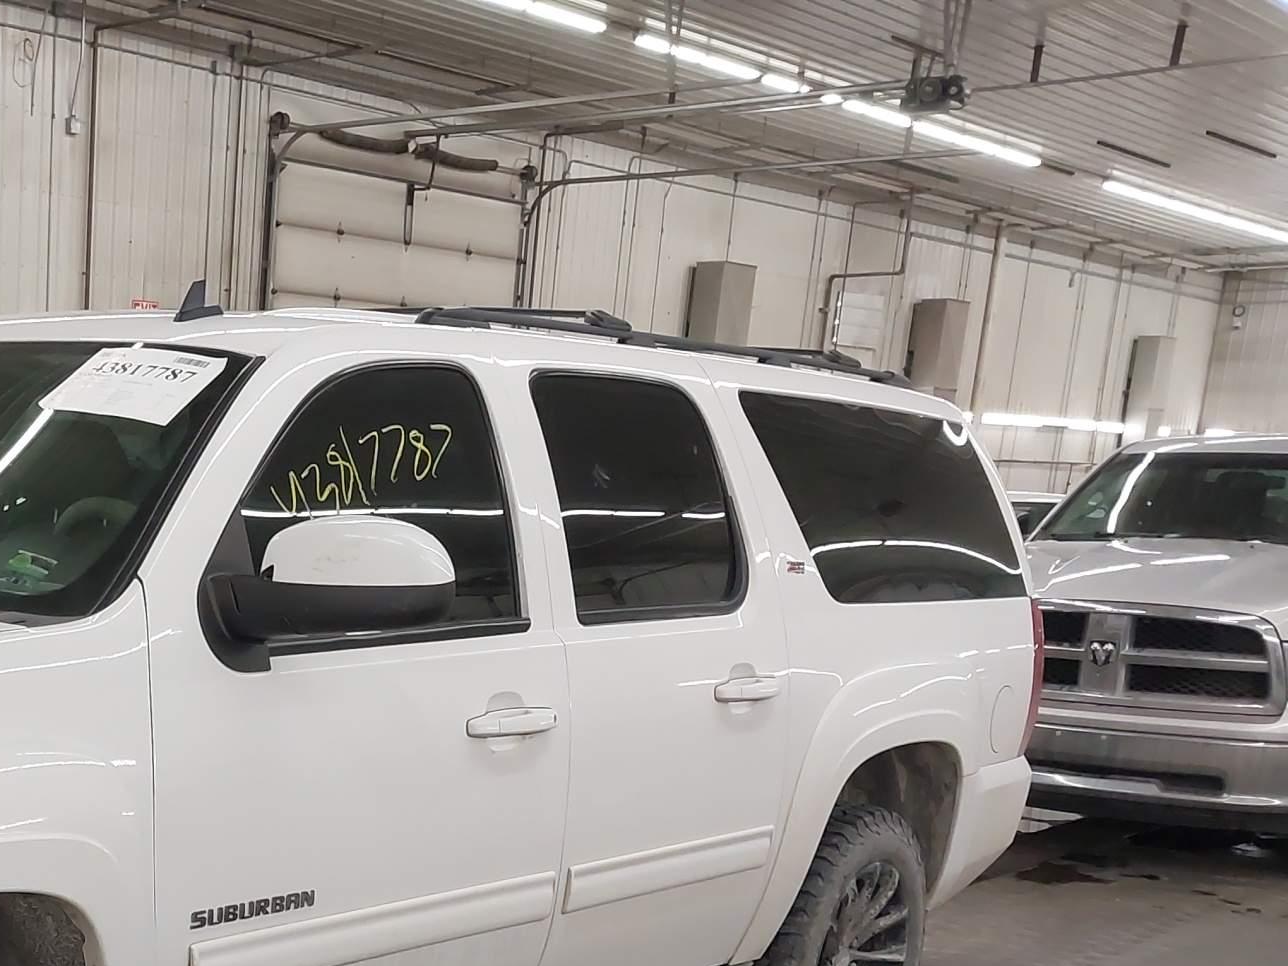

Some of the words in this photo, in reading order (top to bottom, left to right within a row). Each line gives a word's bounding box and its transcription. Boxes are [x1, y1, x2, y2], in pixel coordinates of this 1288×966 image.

[92, 361, 198, 383] 43817787
[270, 424, 452, 519] 43817787
[189, 889, 316, 930] SUBURBAN
